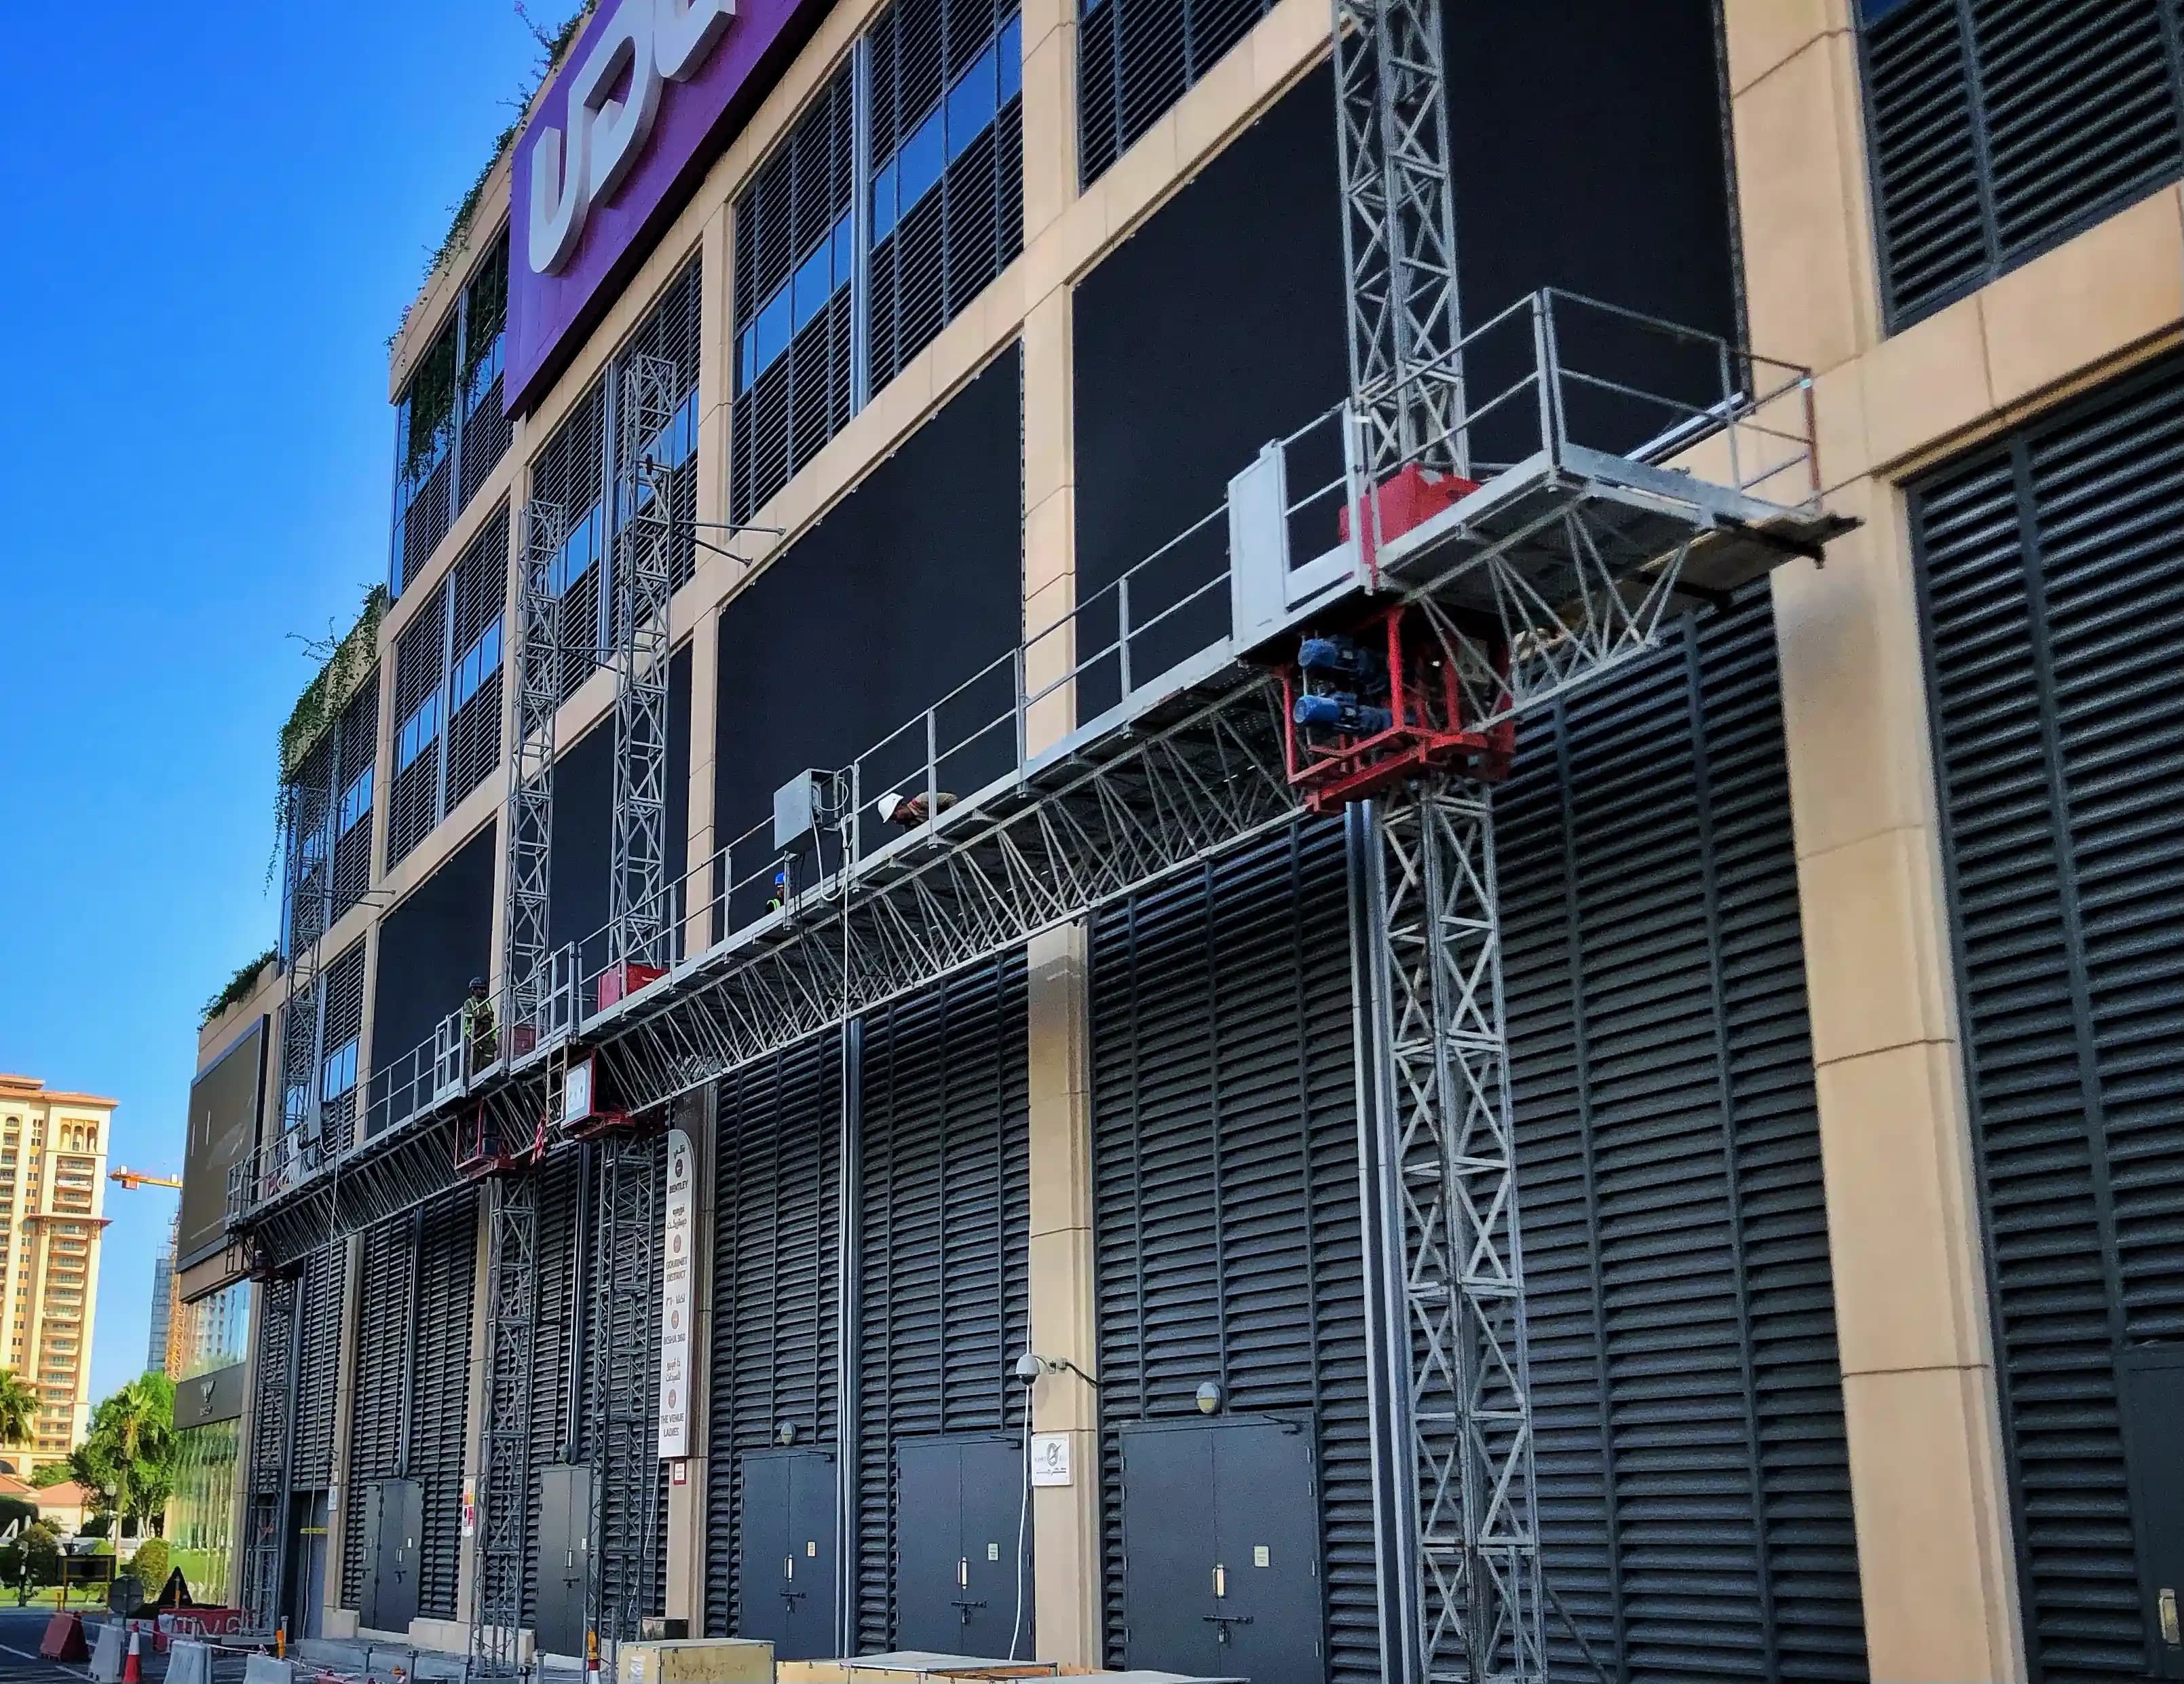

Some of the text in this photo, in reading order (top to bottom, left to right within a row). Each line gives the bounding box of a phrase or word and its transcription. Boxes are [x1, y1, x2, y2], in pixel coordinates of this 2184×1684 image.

[669, 1179, 688, 1194] BENTLEY
[666, 1256, 688, 1269] GOURMET
[666, 1270, 685, 1283] DISTRICT
[660, 1412, 684, 1423] THE VENUE
[663, 1427, 679, 1438] LADIES
